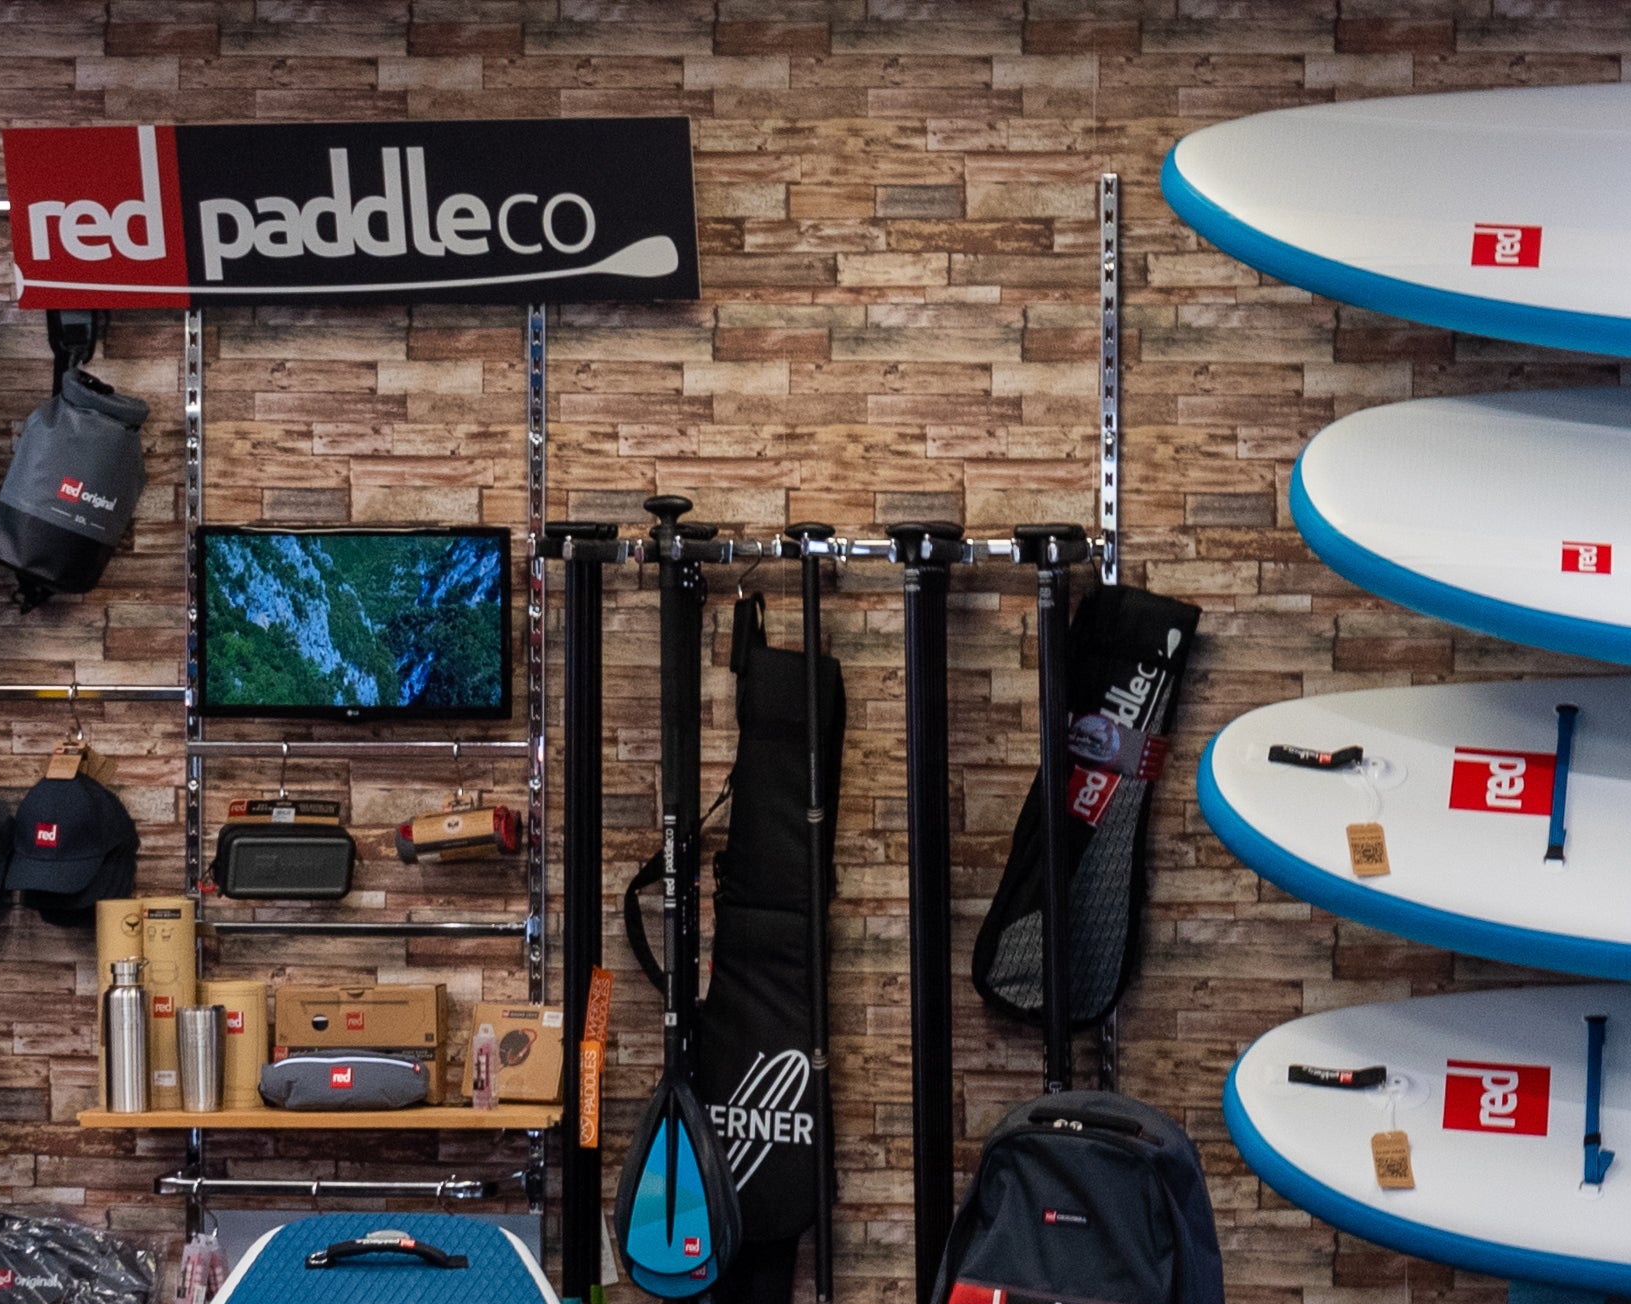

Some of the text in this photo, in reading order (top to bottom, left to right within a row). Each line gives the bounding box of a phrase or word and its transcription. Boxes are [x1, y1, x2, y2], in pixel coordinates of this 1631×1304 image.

[27, 124, 166, 261] red
[1474, 226, 1524, 265] red
[60, 480, 118, 512] red original
[1562, 544, 1598, 573] red
[1073, 770, 1109, 817] red
[1454, 749, 1529, 809] red
[230, 799, 247, 812] red
[38, 824, 57, 841] red
[662, 877, 676, 897] red
[155, 996, 173, 1012] red
[347, 1012, 364, 1027] red
[332, 1067, 353, 1084] red
[583, 1049, 598, 1116] PADDLES
[1446, 1062, 1521, 1131] red
[706, 1104, 815, 1146] ERNER
[684, 1237, 700, 1254] red
[14, 1273, 59, 1288] original
